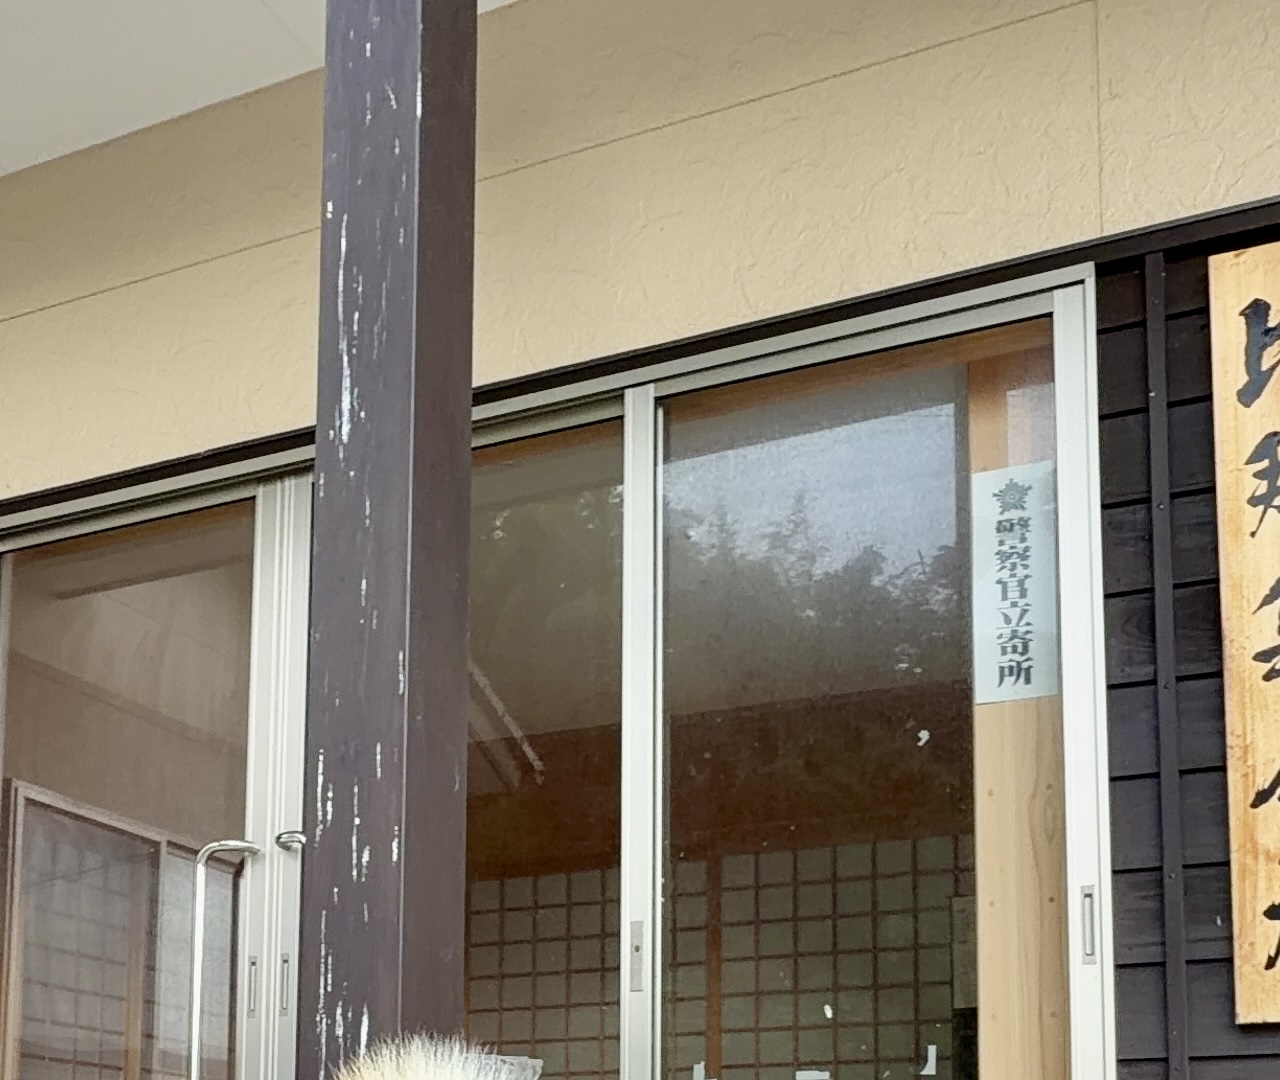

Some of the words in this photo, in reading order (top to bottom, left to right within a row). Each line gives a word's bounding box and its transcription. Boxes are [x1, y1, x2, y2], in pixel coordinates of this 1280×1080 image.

[995, 517, 1033, 688] 警察官立寄所
